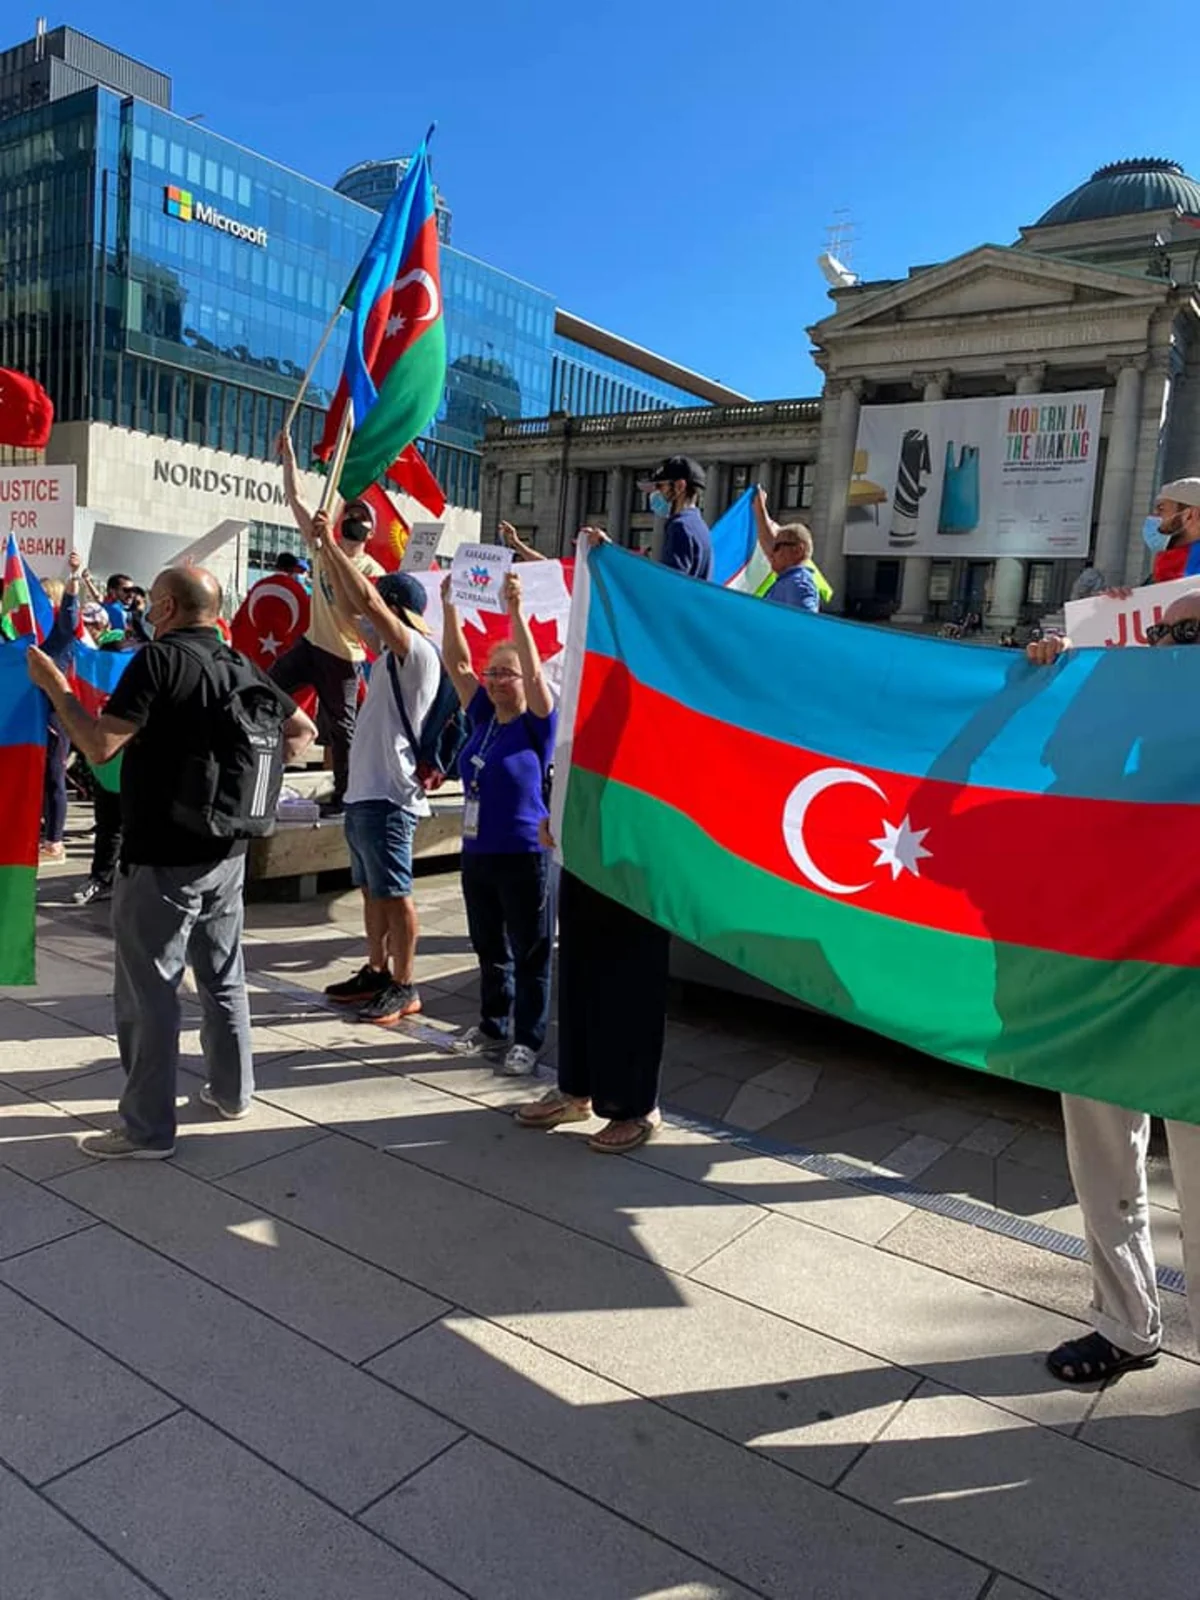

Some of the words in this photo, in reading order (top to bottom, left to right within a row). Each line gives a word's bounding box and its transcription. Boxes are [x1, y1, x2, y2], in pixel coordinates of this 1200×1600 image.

[195, 201, 268, 248] Microsoft
[1008, 405, 1067, 433] MODERN
[1071, 404, 1087, 430] IN
[1006, 434, 1032, 460] THE
[1035, 431, 1090, 460] MAKING
[0, 479, 60, 502] USTICE
[153, 459, 289, 507] NORDSTROM
[10, 510, 38, 529] FOR
[1, 536, 66, 556] AABAKH
